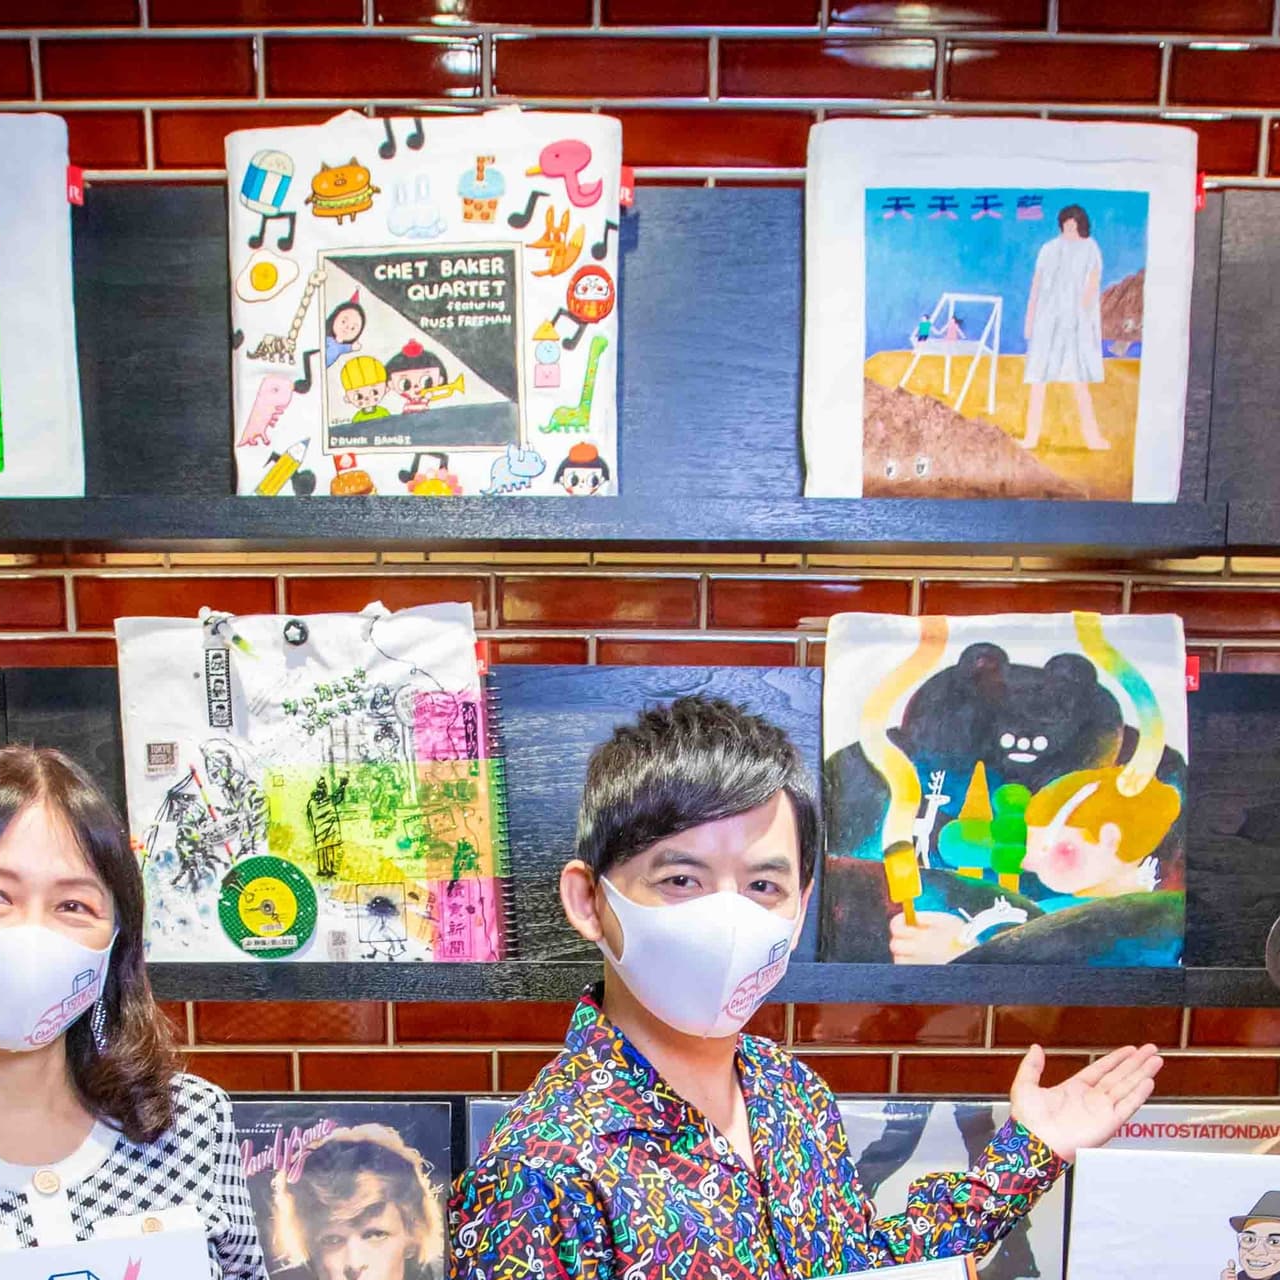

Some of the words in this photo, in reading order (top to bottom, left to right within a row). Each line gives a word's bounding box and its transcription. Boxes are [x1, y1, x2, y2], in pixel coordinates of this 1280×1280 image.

[374, 261, 428, 281] CHET
[440, 257, 506, 277] BAKER
[407, 280, 507, 301] QUARTET
[420, 316, 454, 328] RUSS
[458, 315, 512, 328] FREEMAN
